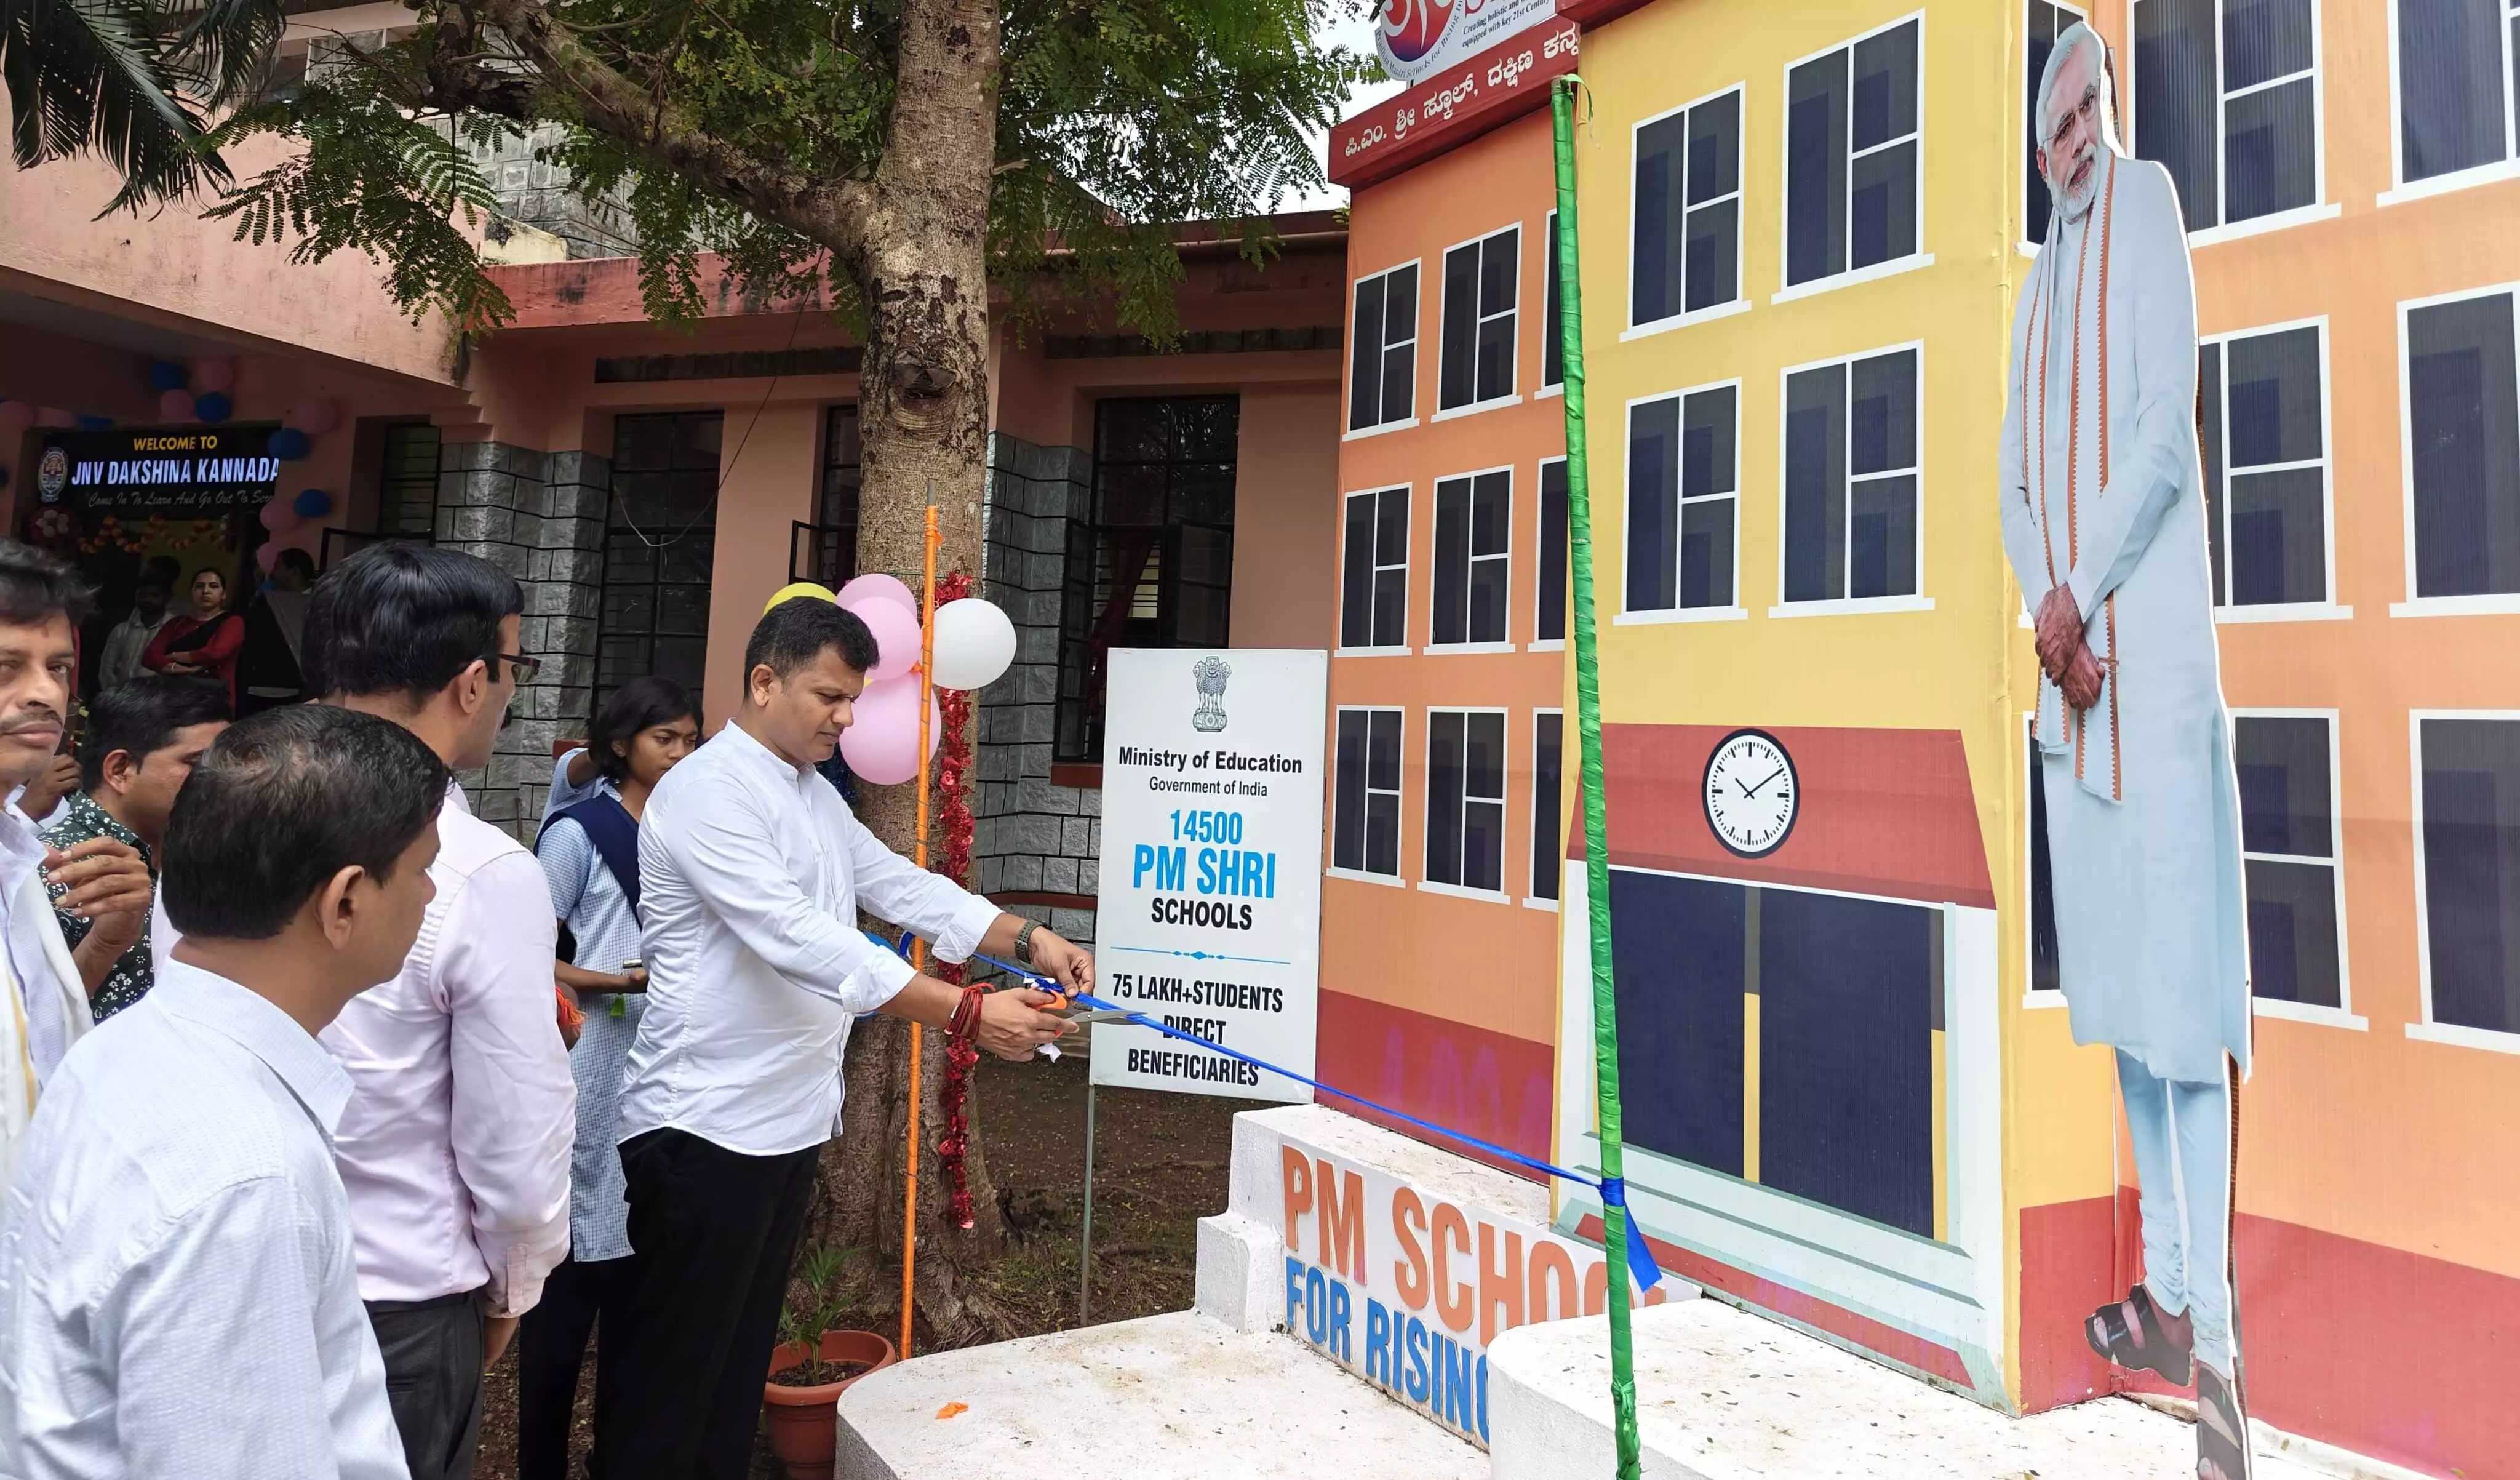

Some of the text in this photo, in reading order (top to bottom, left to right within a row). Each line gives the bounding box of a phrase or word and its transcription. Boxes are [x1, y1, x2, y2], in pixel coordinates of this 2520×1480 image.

[1462, 28, 1488, 47] equipped
[1489, 22, 1500, 33] with
[1502, 15, 1512, 27] key
[1513, 7, 1524, 20] 21st
[1463, 17, 1487, 35] Creating
[1488, 5, 1508, 22] holistic
[1509, 0, 1519, 10] and
[1431, 47, 1441, 61] for
[1441, 15, 1460, 47] Rising
[1394, 108, 1415, 140] ಶ್ರೀ
[1488, 50, 1533, 87] ದಕ್ಷಿಣ
[134, 435, 218, 450] WELCOME TO
[71, 462, 105, 485] JNV
[108, 459, 191, 484] DAKSHINA
[197, 457, 280, 482] KANNADA
[117, 492, 127, 505] In
[131, 492, 142, 505] To
[145, 492, 172, 505] Learn
[173, 491, 196, 505] And
[198, 491, 212, 508] Go
[216, 490, 234, 504] Out
[237, 490, 248, 503] To
[1118, 746, 1302, 774] Ministry of Education
[1149, 776, 1267, 796] Government of India
[1170, 809, 1243, 845] 14500
[1133, 844, 1275, 898] PM SHRI
[1151, 897, 1252, 930] SCHOOLS
[1112, 974, 1283, 1013] 75 LAKH+STUDENTS
[1163, 1015, 1226, 1044] DIRECT
[1128, 1048, 1259, 1086] BENEFICIARIES
[1282, 1143, 1367, 1286] PM
[1285, 1257, 1354, 1364] FOR
